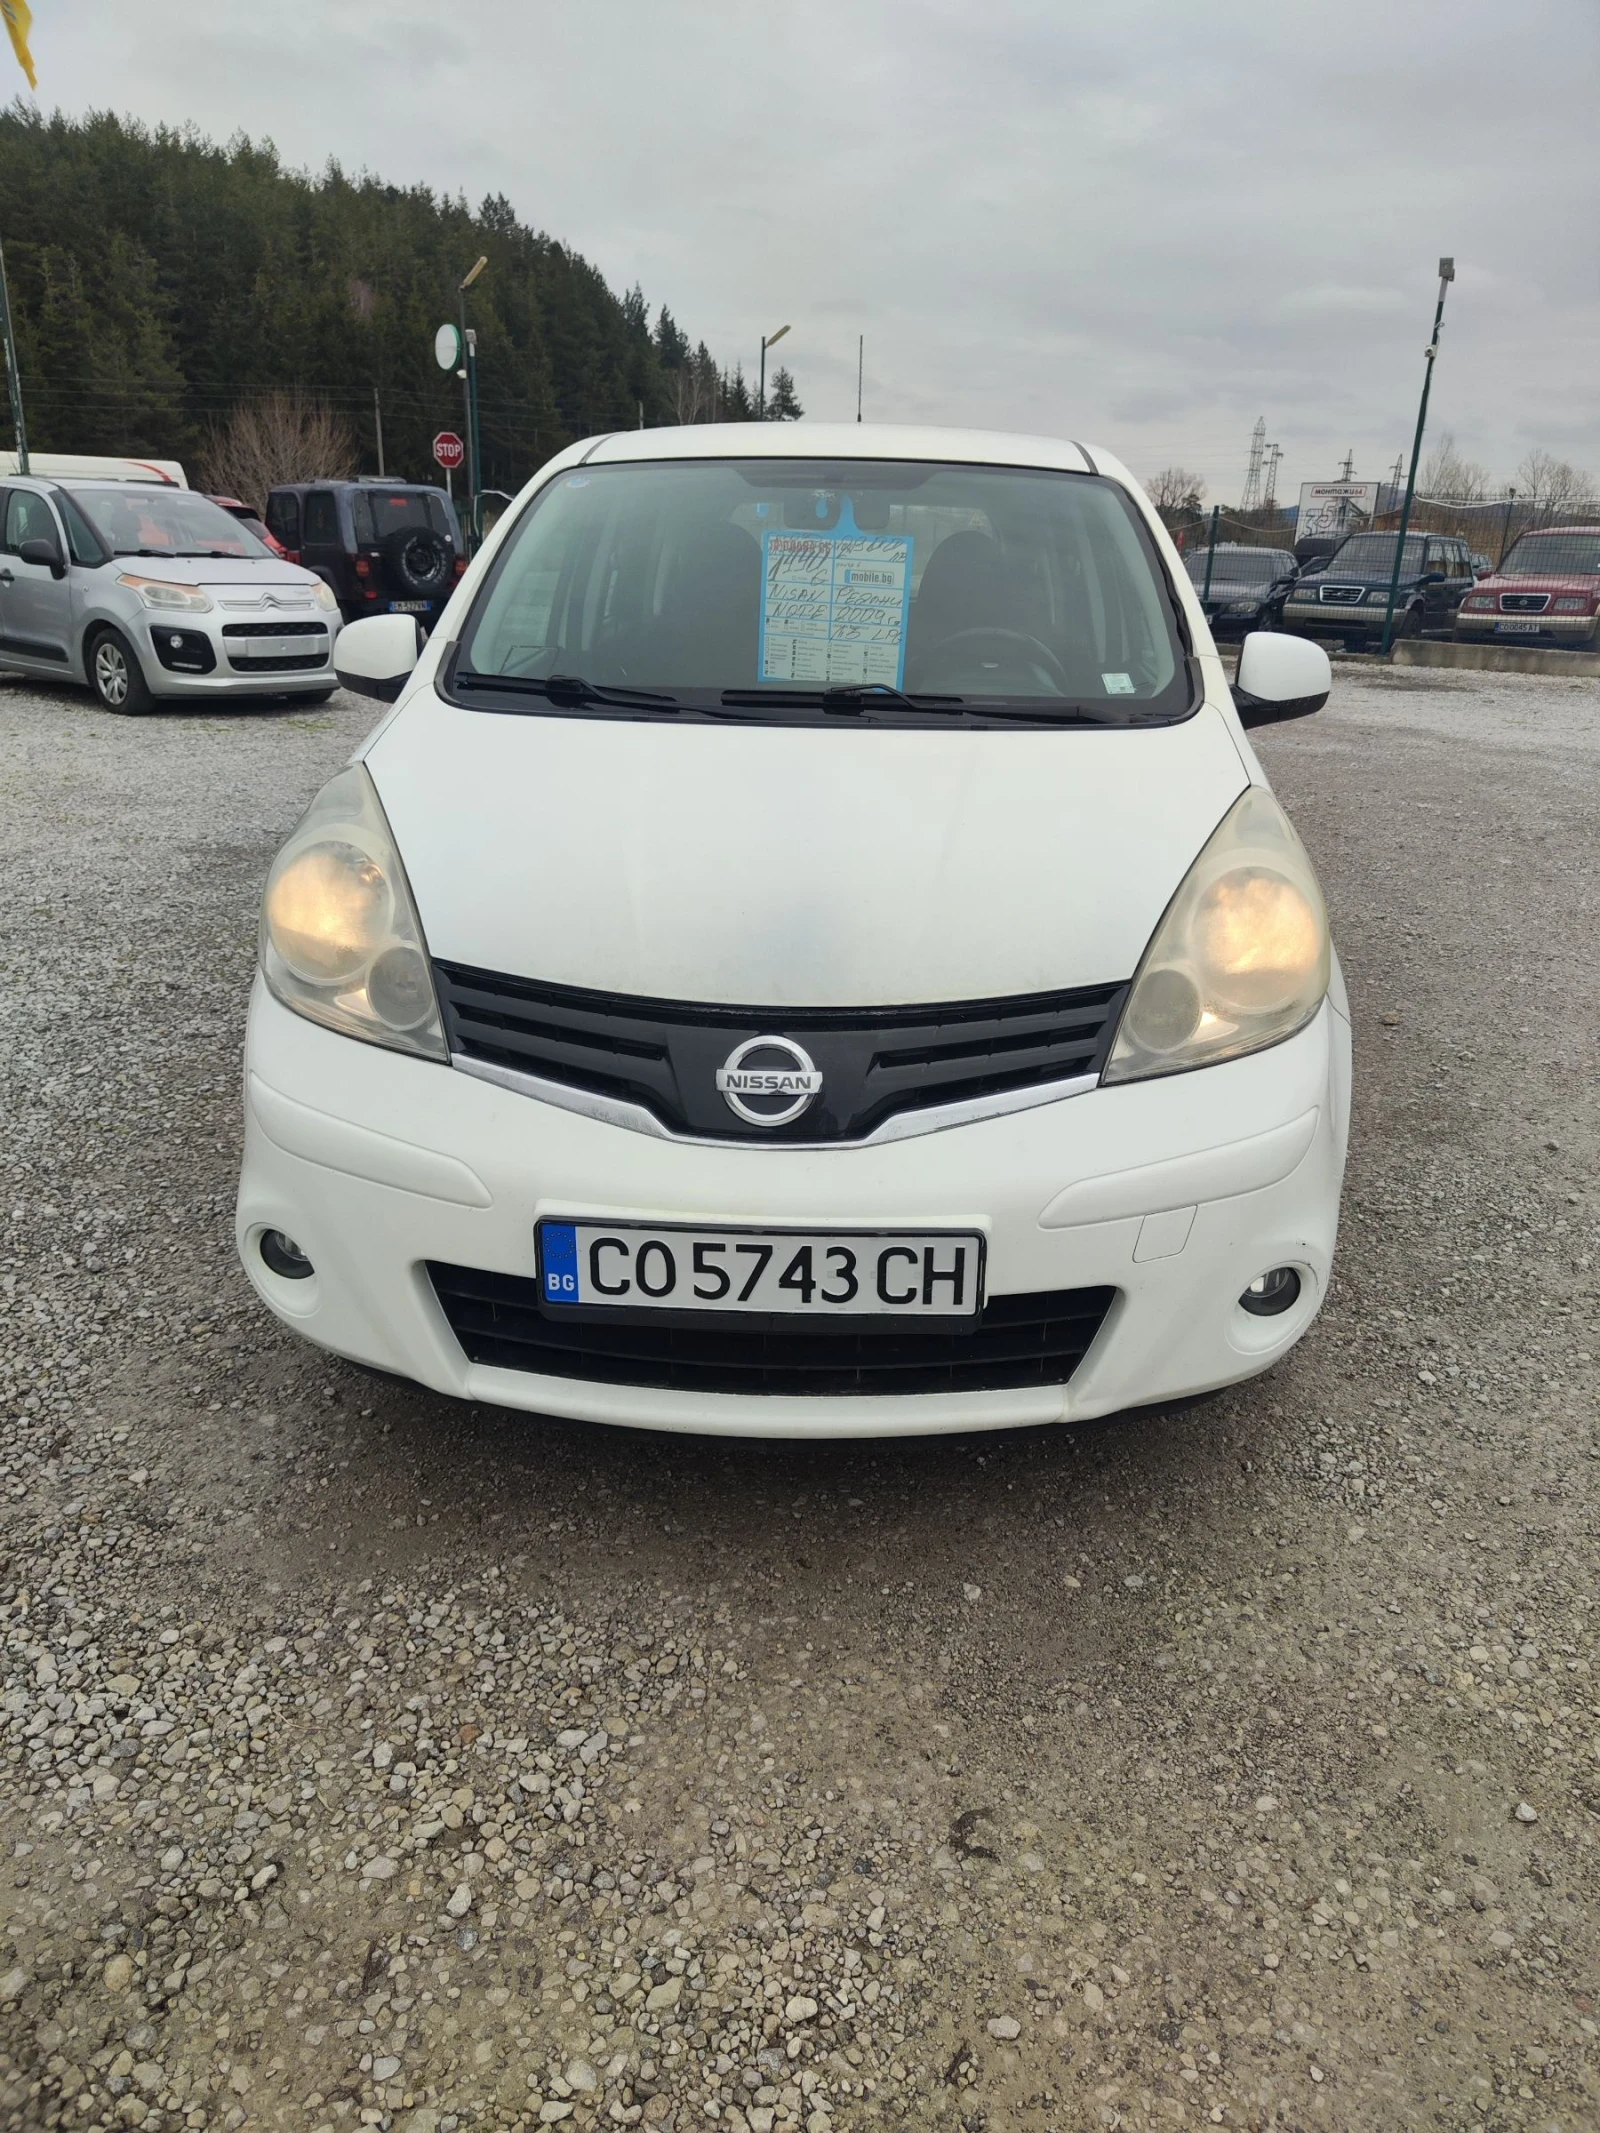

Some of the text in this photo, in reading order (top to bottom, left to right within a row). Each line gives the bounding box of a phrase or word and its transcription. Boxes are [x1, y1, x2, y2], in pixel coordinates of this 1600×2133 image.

[436, 443, 461, 457] STOP
[851, 572, 893, 585] mobile.bg
[769, 583, 825, 603] NISAN
[773, 602, 828, 620] NOTE
[835, 605, 886, 625] 2009
[725, 1073, 812, 1091] NISSAN
[588, 1237, 966, 1306] CO 5743 CH
[547, 1273, 575, 1292] BG
